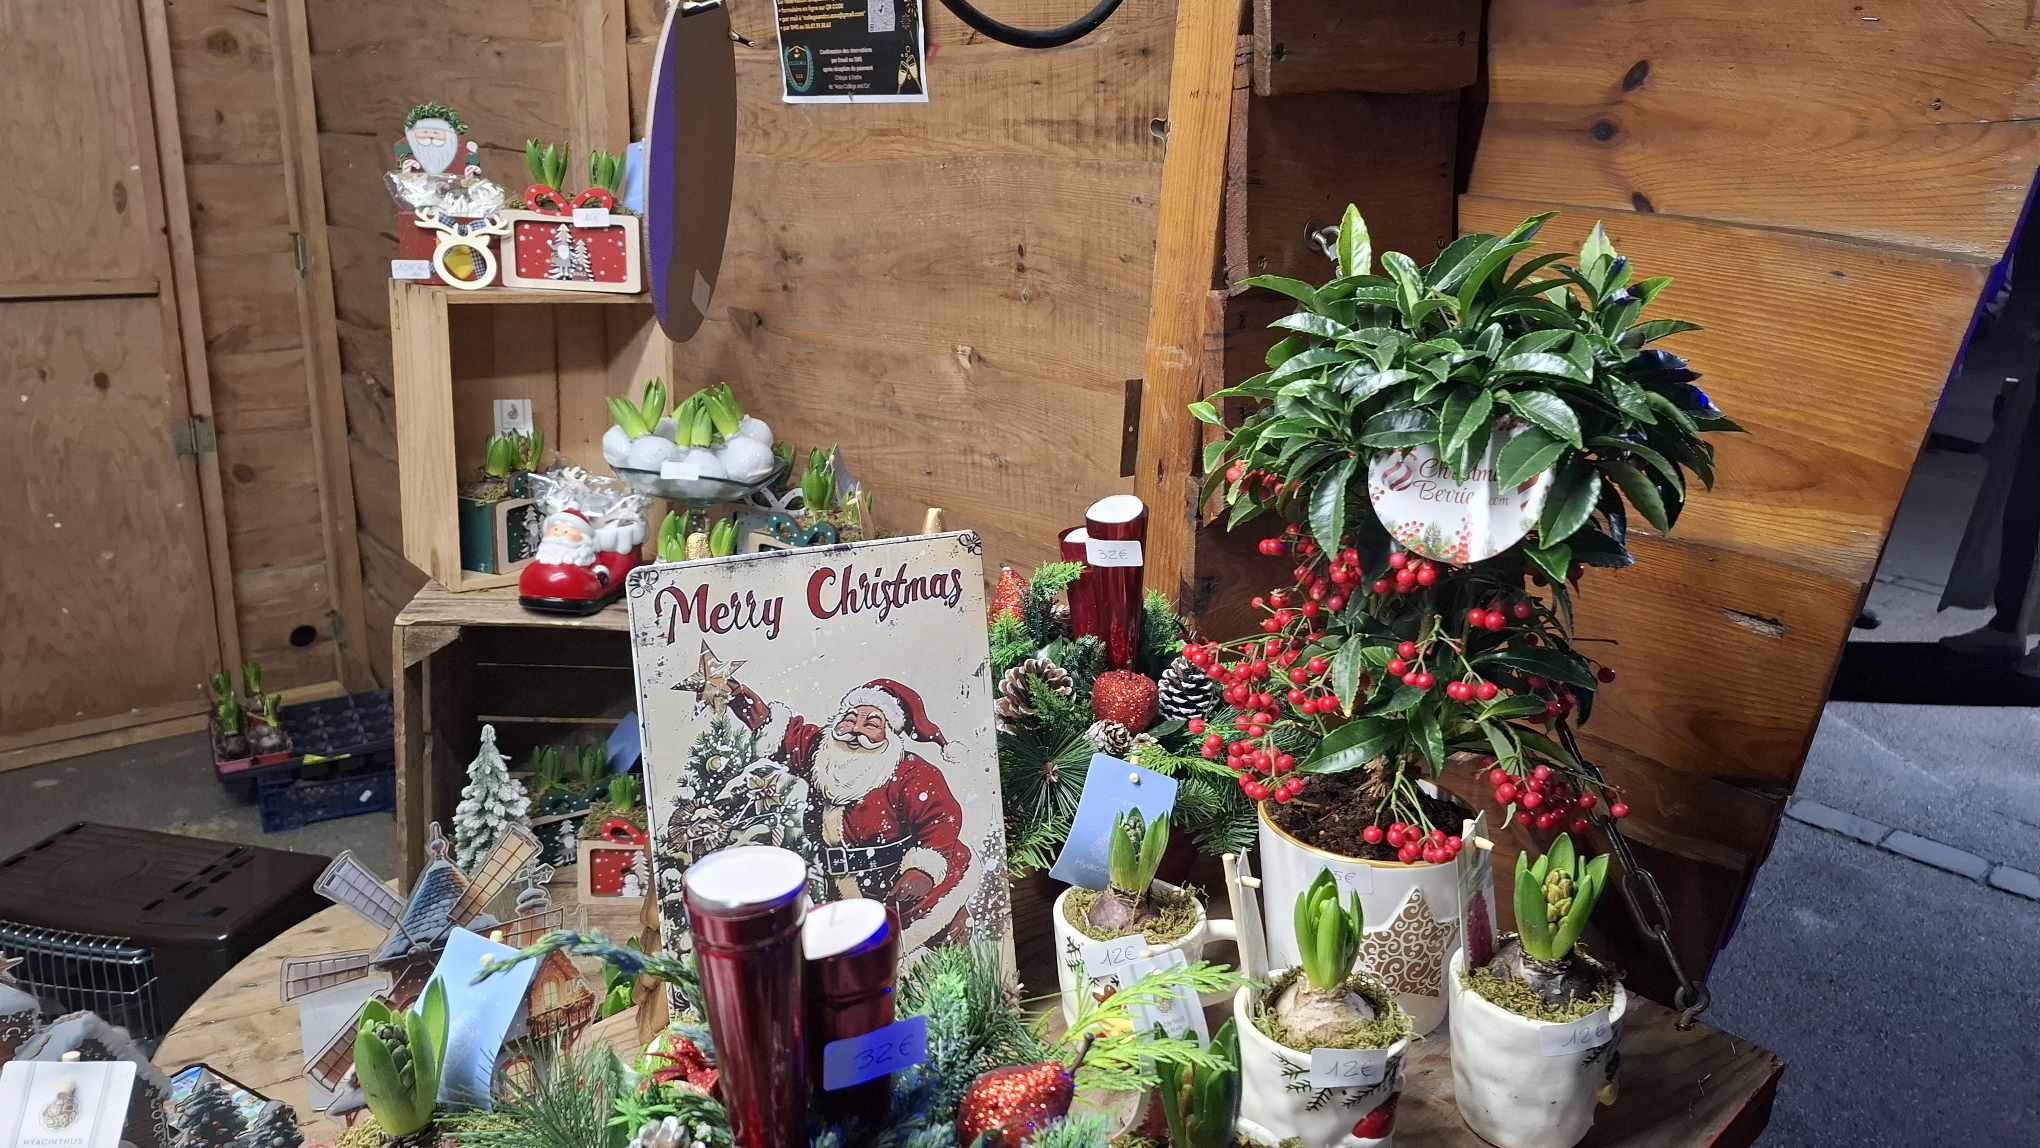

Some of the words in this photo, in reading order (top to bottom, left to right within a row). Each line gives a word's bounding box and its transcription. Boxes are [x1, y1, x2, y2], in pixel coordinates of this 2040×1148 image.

[1098, 548, 1129, 560] 32€
[654, 583, 784, 646] Merry
[806, 563, 963, 623] Christmas
[1100, 945, 1138, 967] 12€
[855, 1034, 914, 1070] 32€
[1325, 1059, 1375, 1078] 12€
